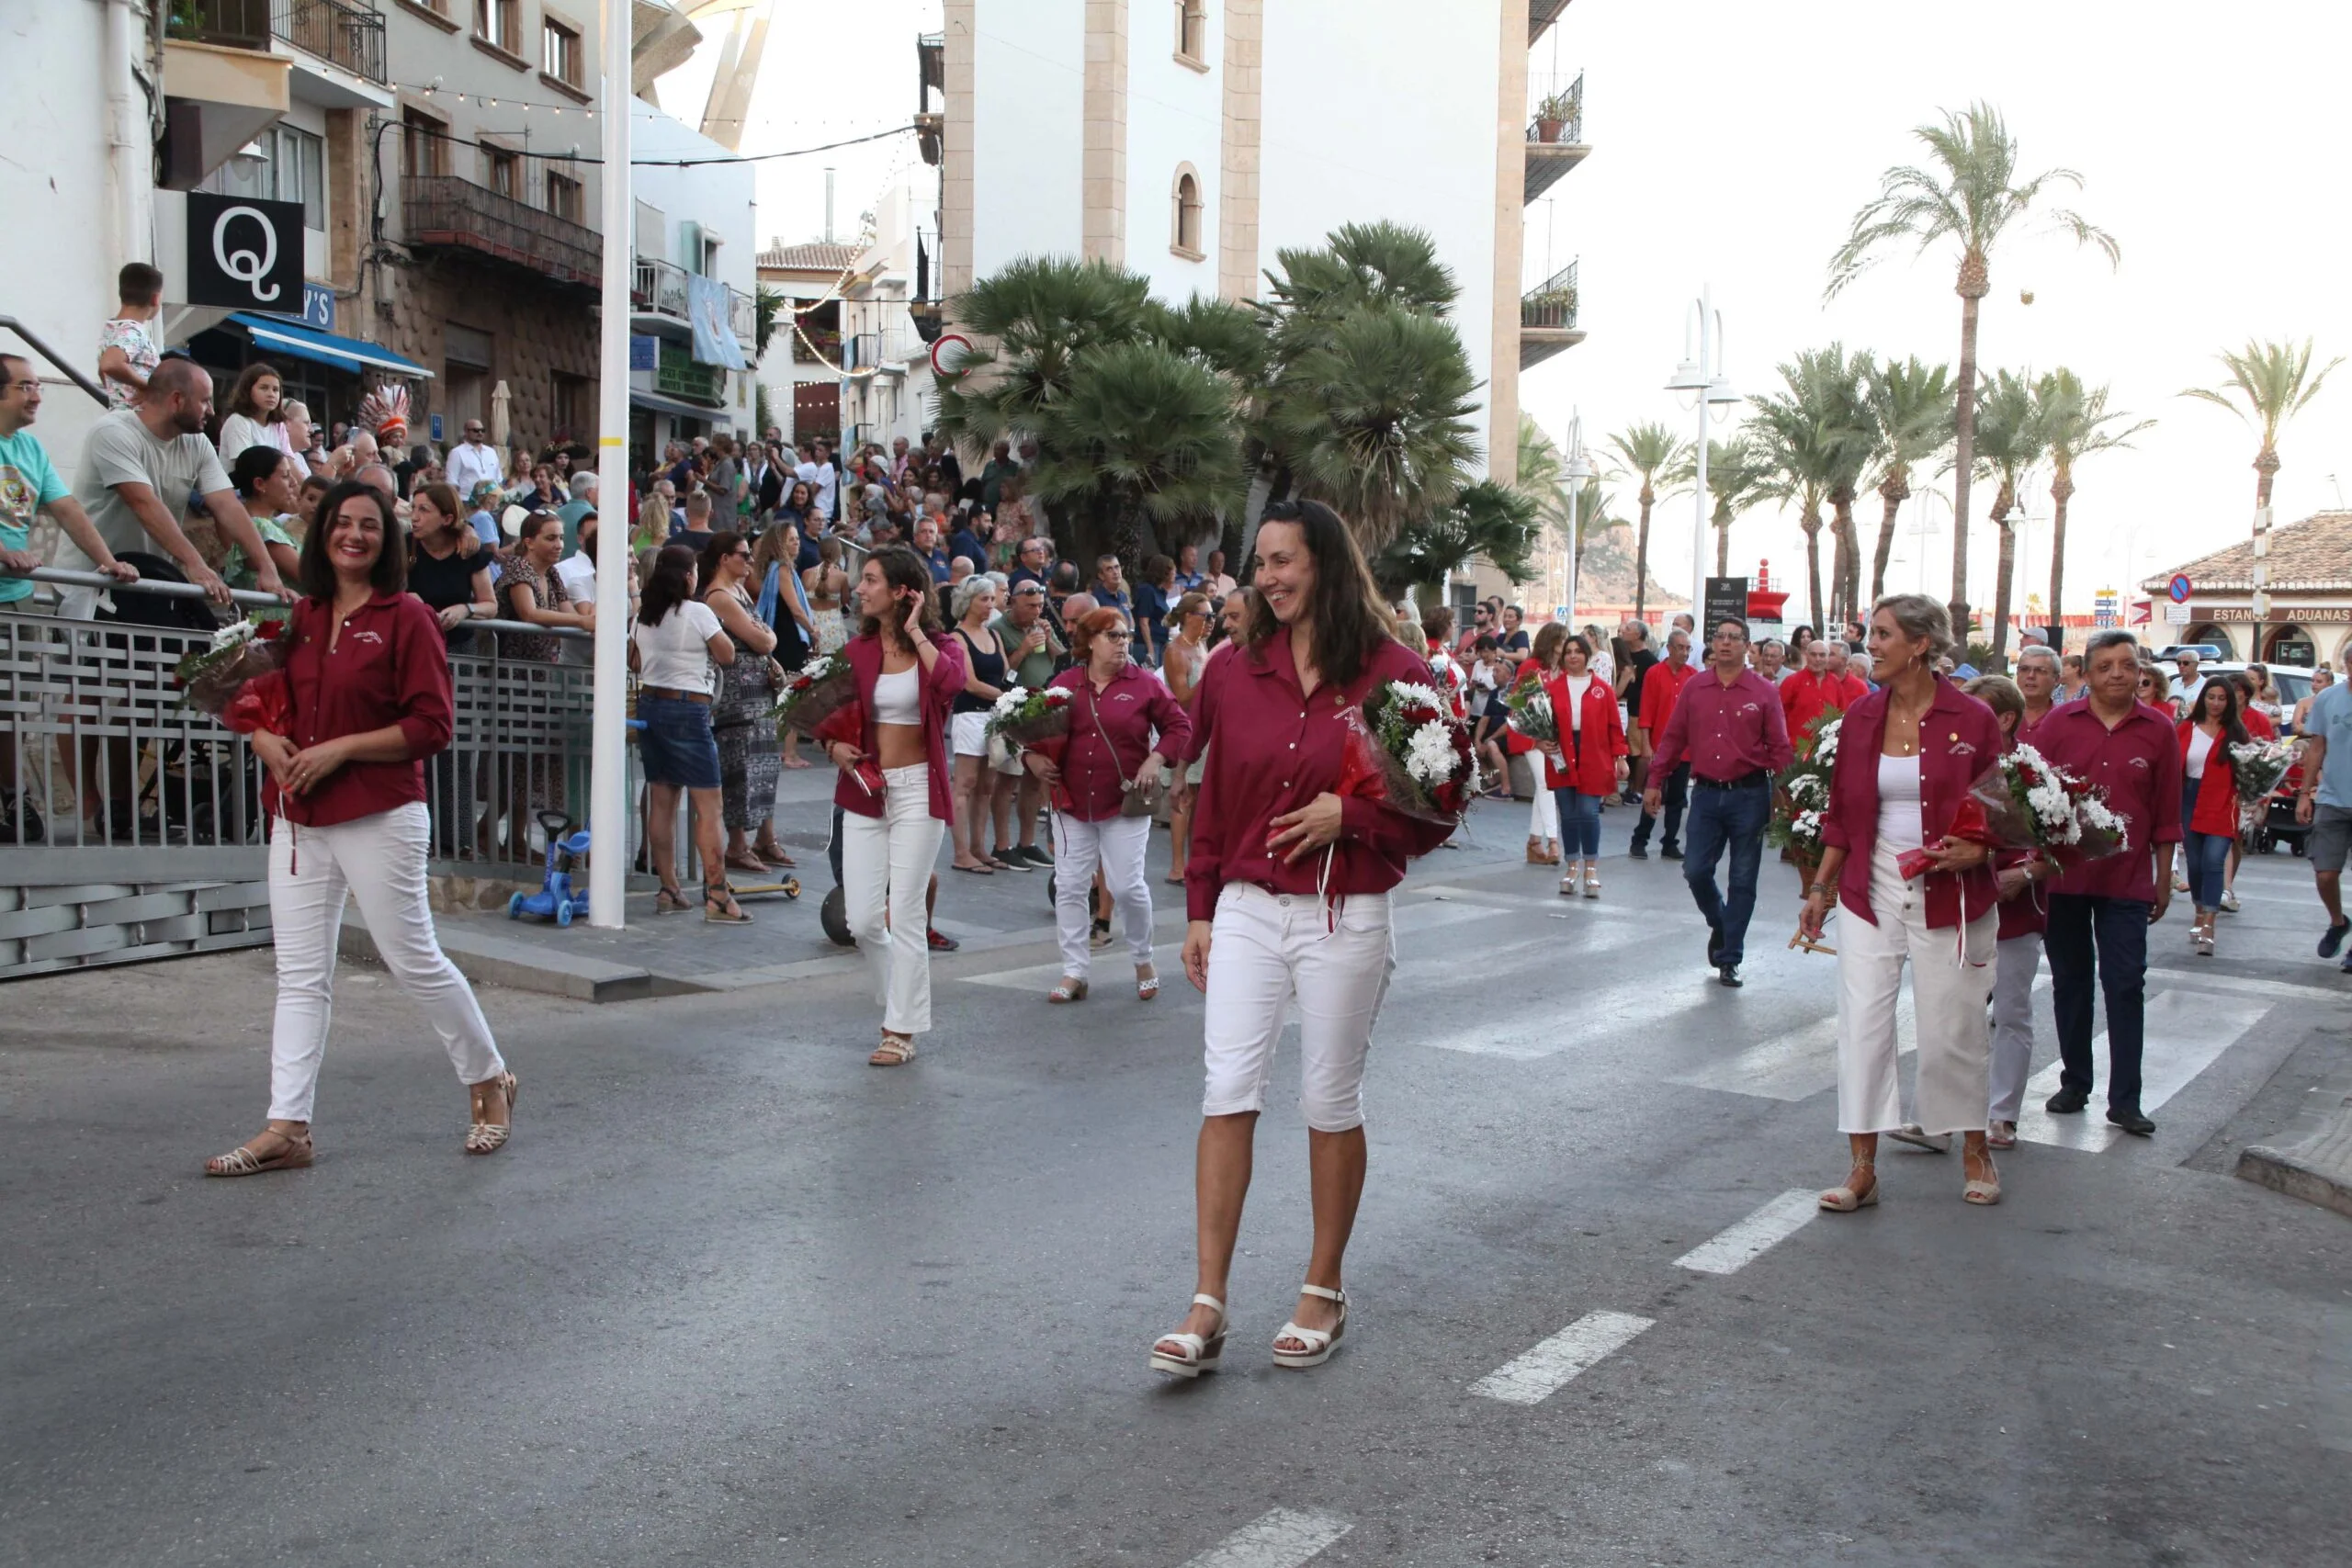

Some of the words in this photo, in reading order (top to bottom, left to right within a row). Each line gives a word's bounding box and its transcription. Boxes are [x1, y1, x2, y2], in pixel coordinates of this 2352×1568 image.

[212, 206, 281, 301] Q
[434, 417, 441, 431] H
[2213, 609, 2269, 621] ESTAN
[2287, 609, 2350, 621] ADUANAS
